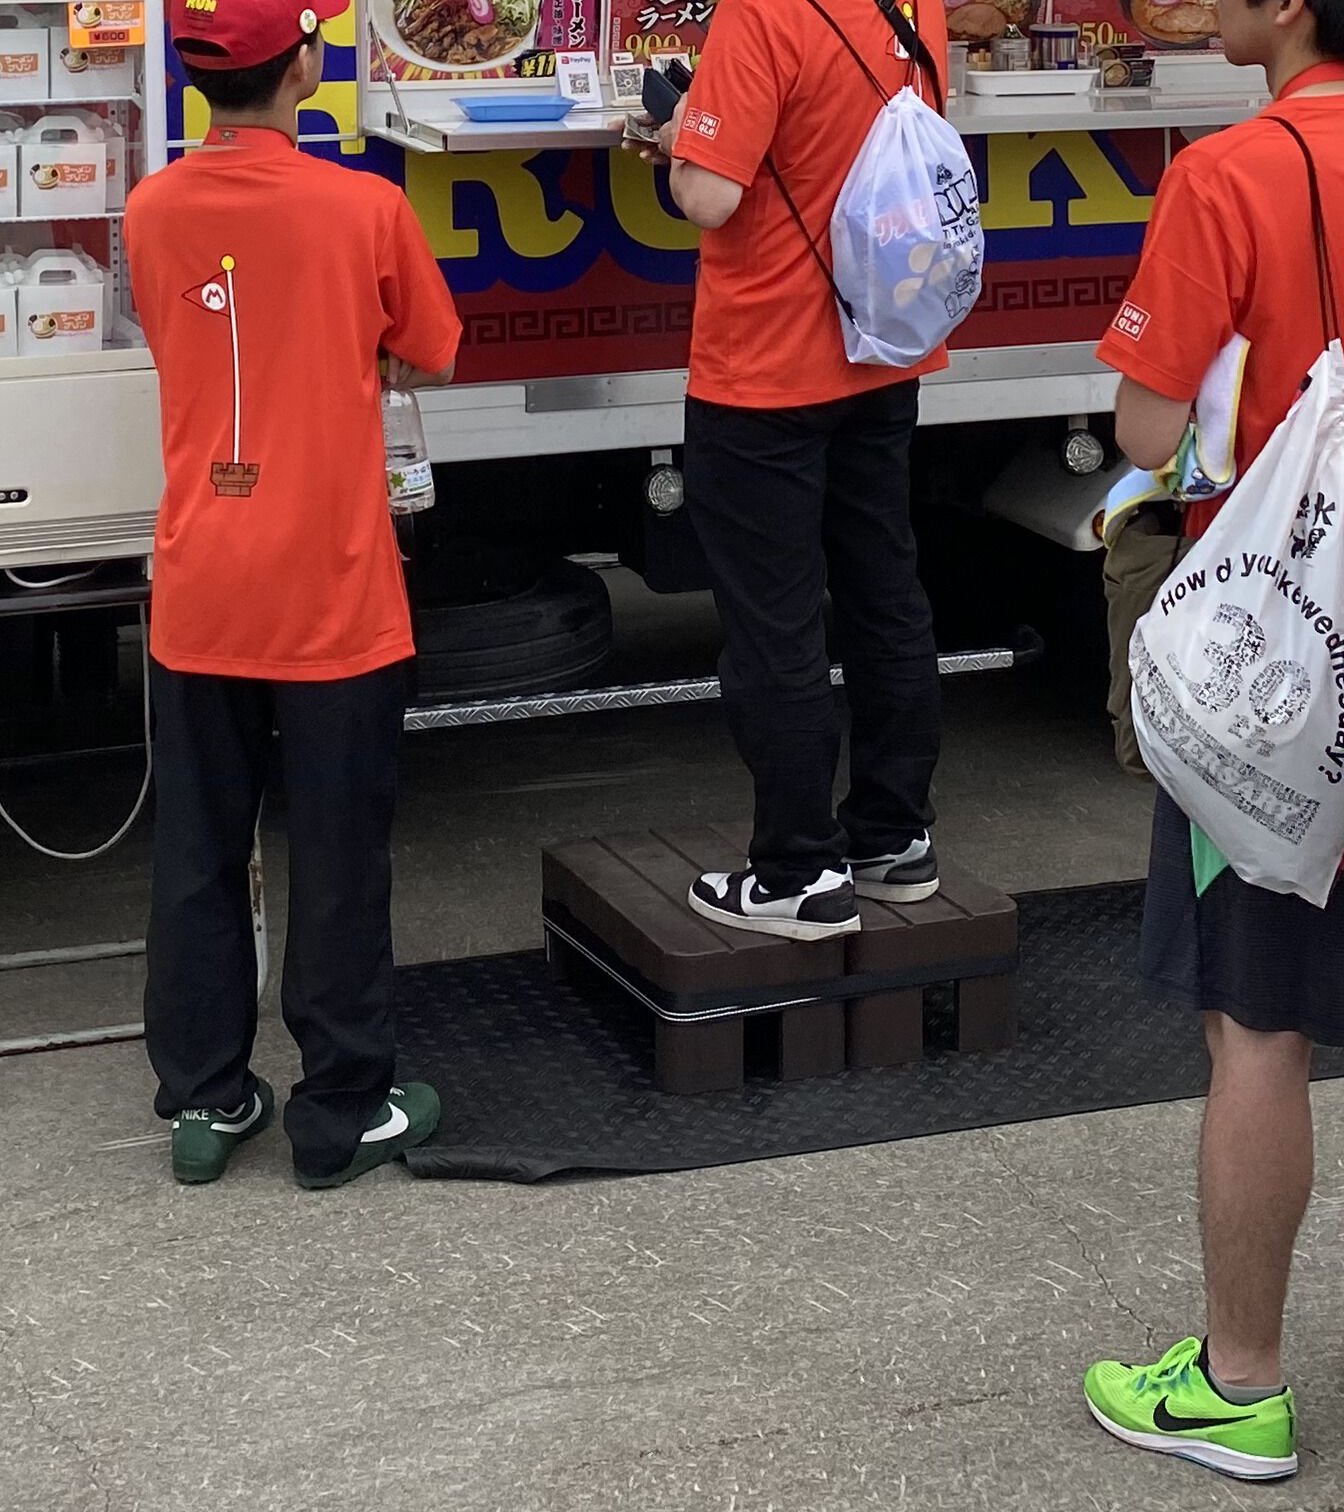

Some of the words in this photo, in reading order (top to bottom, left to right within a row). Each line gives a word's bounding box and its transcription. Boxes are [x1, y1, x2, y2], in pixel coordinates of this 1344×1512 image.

[636, 1, 714, 31] ラーメン
[1077, 20, 1128, 45] 50円
[521, 53, 556, 79] ¥11
[1160, 568, 1207, 616] How
